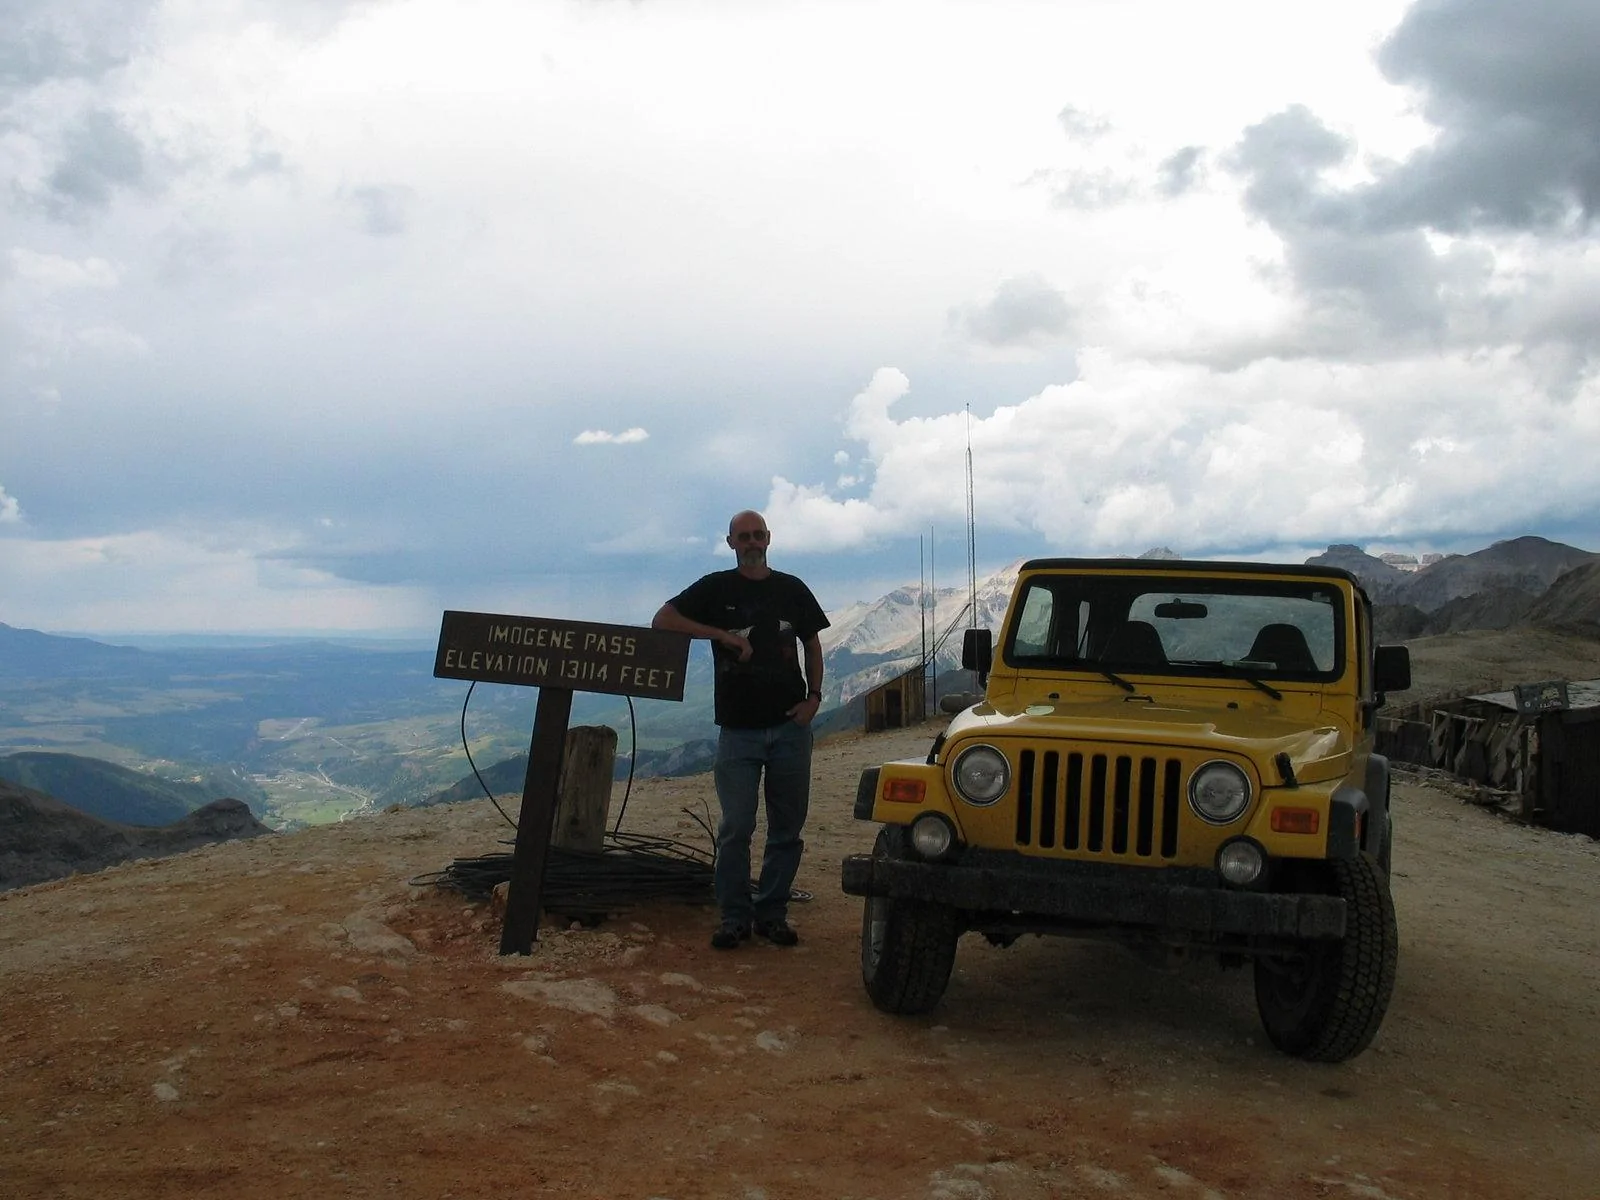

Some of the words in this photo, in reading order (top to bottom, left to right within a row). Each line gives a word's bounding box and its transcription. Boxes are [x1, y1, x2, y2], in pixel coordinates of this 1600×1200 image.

[488, 625, 575, 649] IMOGENE
[584, 633, 636, 656] PASS
[445, 649, 549, 676] ELEVATION
[560, 659, 608, 682] 13114
[620, 665, 675, 689] FEET
